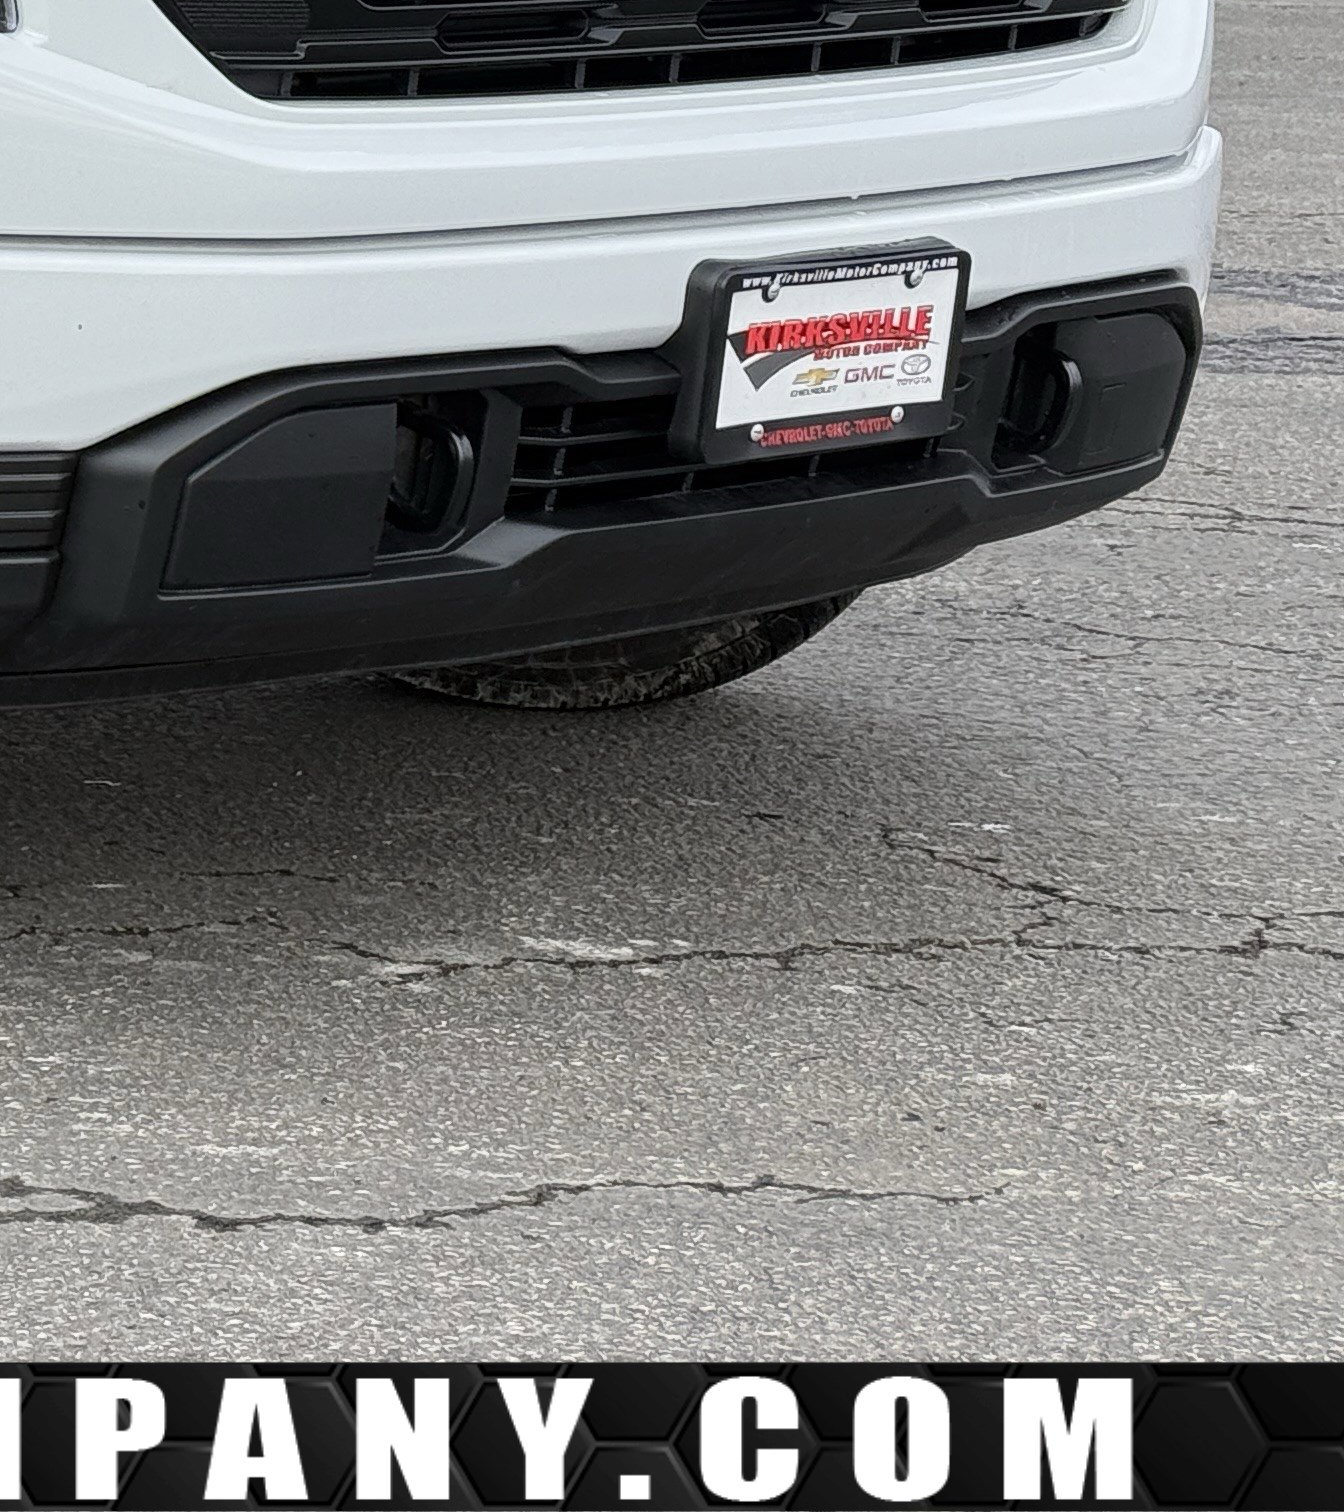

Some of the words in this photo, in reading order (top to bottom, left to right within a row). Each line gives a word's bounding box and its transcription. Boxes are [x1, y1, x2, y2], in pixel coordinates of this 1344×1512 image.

[744, 305, 934, 355] KIRKSVILLE
[813, 345, 861, 361] MOTOR
[863, 339, 930, 357] COMPANY
[844, 364, 896, 384] GMC
[896, 375, 932, 387] TOYOTA
